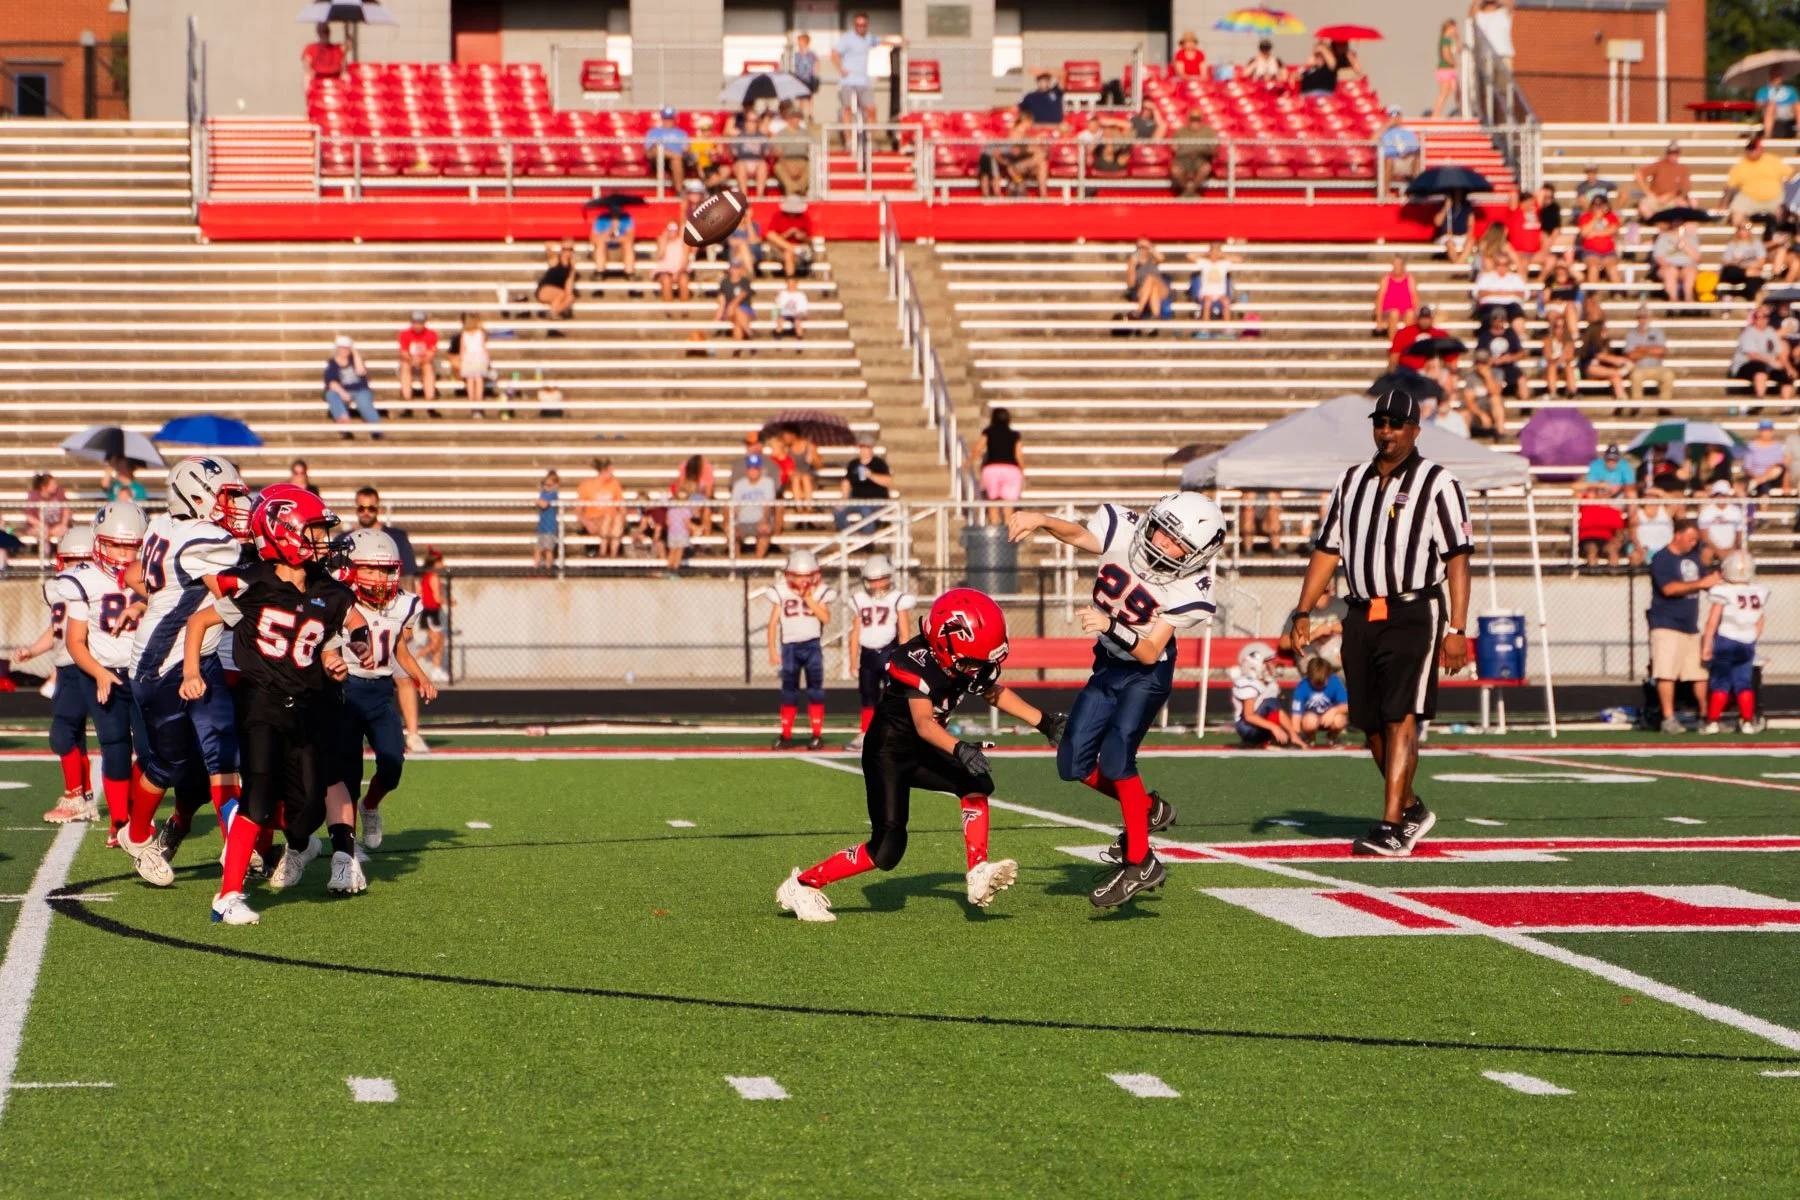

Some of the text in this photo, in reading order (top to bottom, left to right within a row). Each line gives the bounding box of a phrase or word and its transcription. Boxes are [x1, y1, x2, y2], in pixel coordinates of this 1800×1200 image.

[861, 606, 890, 627] 87
[1093, 562, 1161, 626] 29
[256, 606, 325, 669] 58
